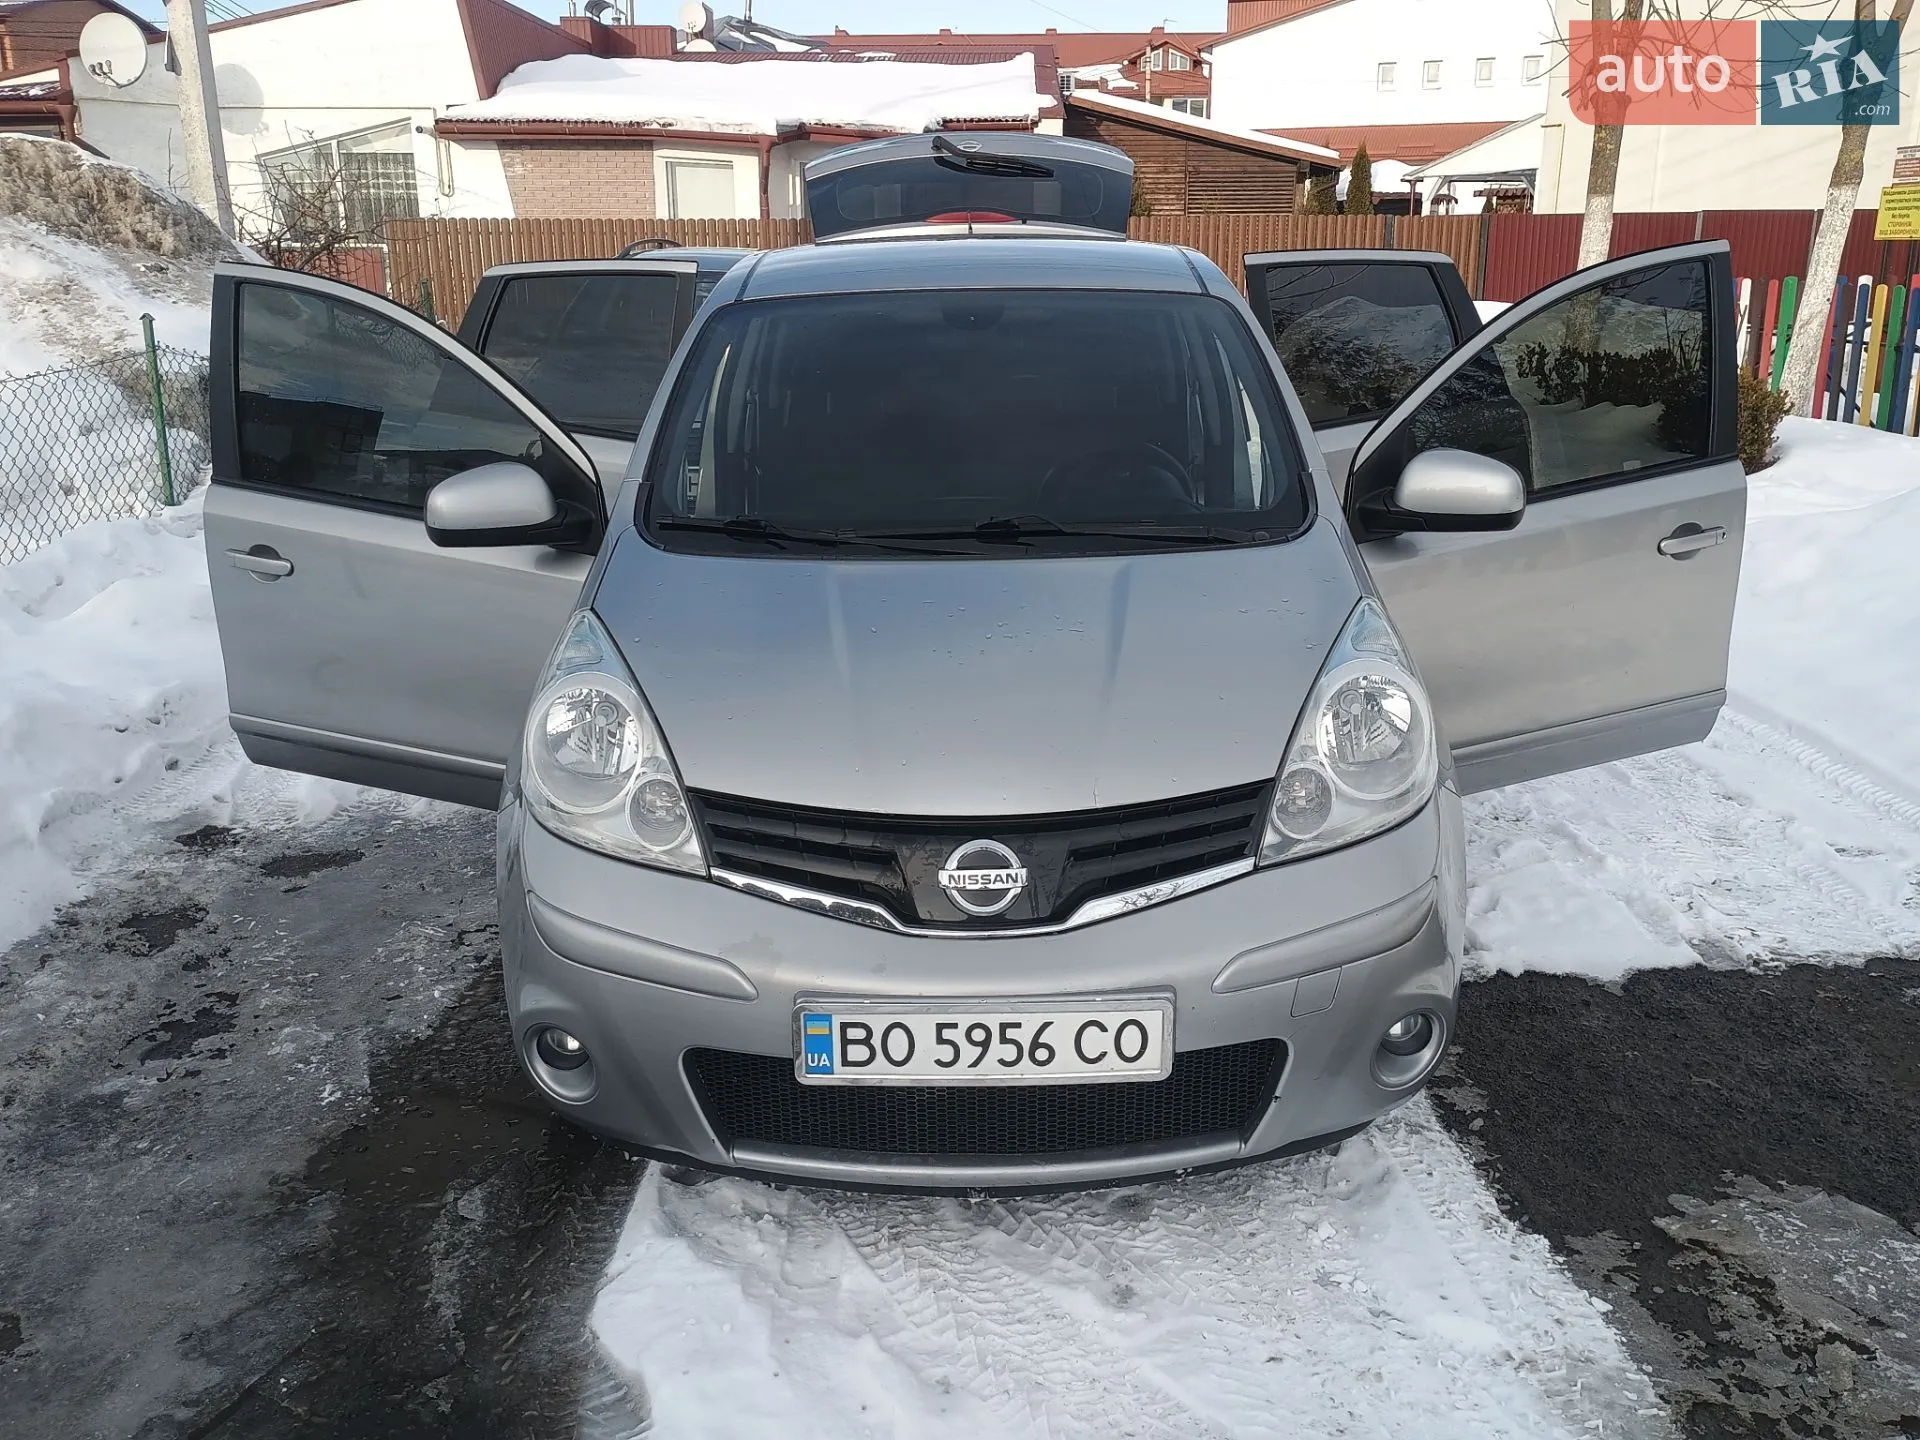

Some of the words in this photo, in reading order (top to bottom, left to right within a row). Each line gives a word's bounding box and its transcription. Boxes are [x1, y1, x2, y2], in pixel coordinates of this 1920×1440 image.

[948, 872, 1019, 886] NISSAN
[839, 1021, 916, 1068] BO
[933, 1020, 1056, 1069] 5956
[1073, 1018, 1149, 1065] CO
[807, 1053, 831, 1068] UA
